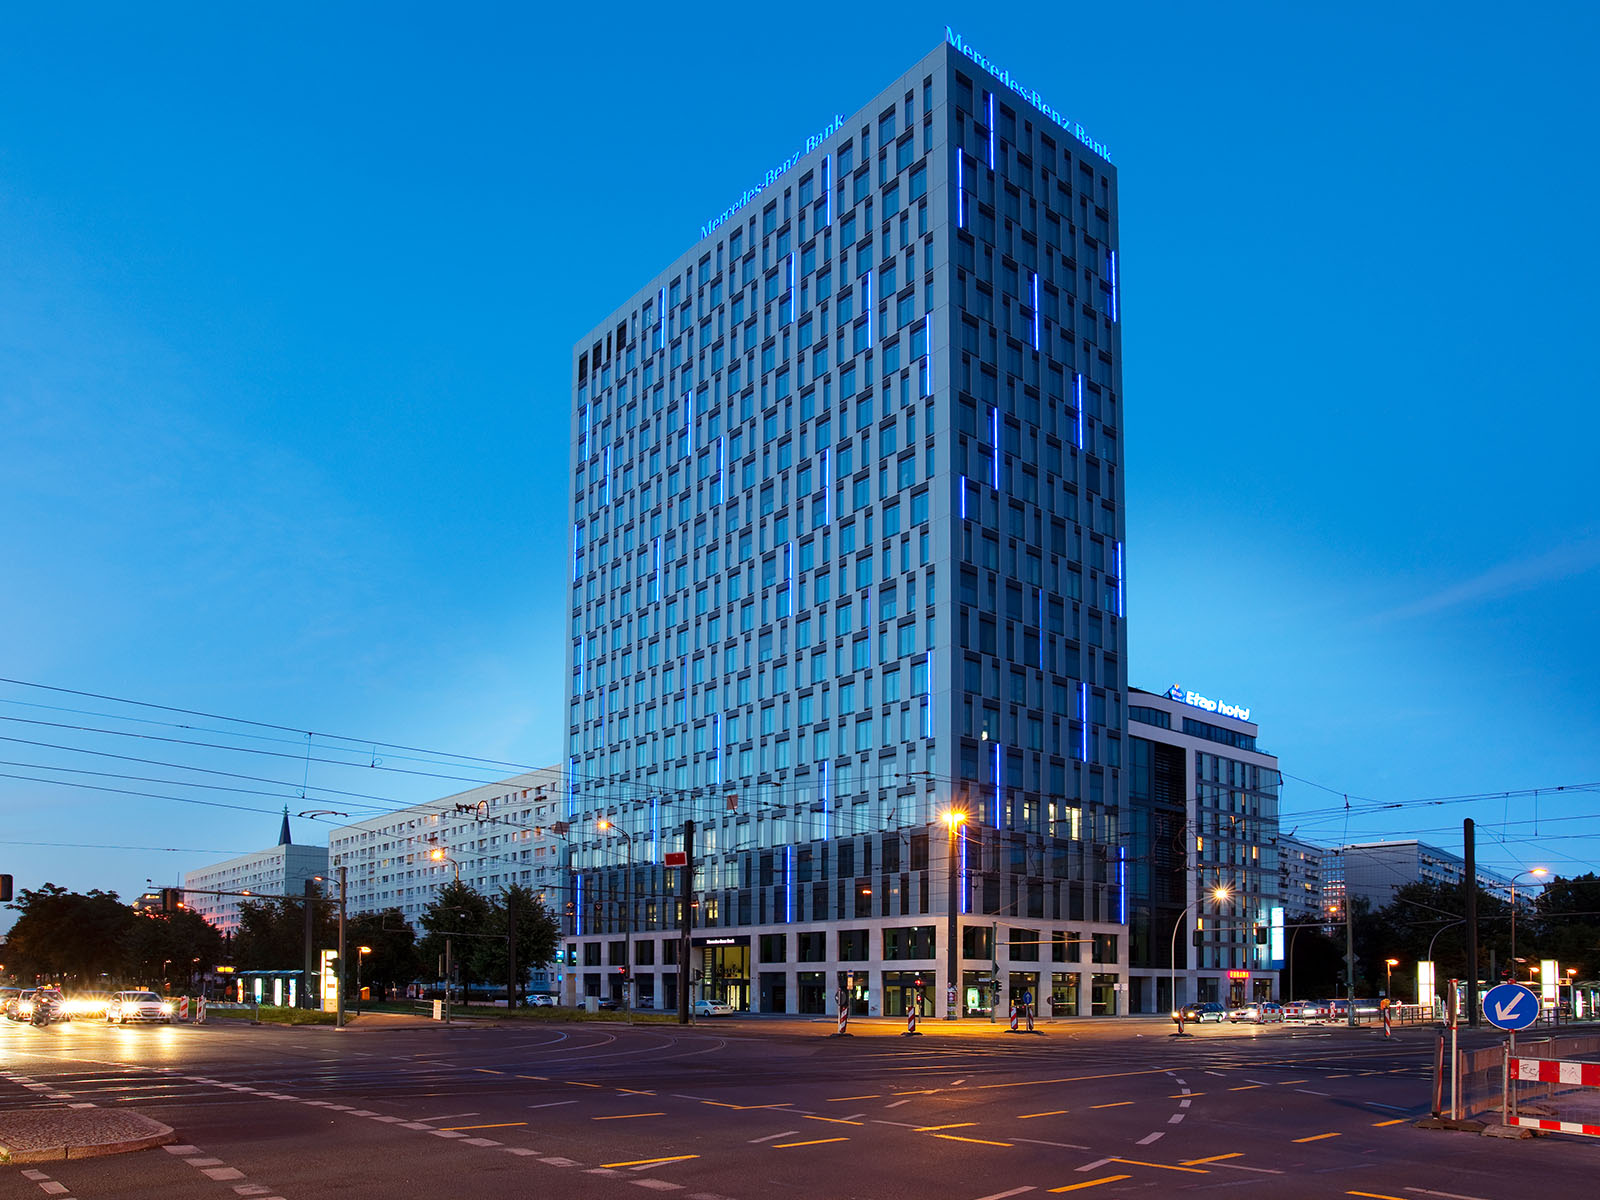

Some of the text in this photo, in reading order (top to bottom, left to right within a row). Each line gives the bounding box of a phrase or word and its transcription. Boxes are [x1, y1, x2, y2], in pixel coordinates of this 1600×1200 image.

[945, 25, 1112, 163] Mercedes-Benz Bank
[700, 113, 845, 240] Mercedes-Benz Bank
[1186, 690, 1250, 721] Etap hotel
